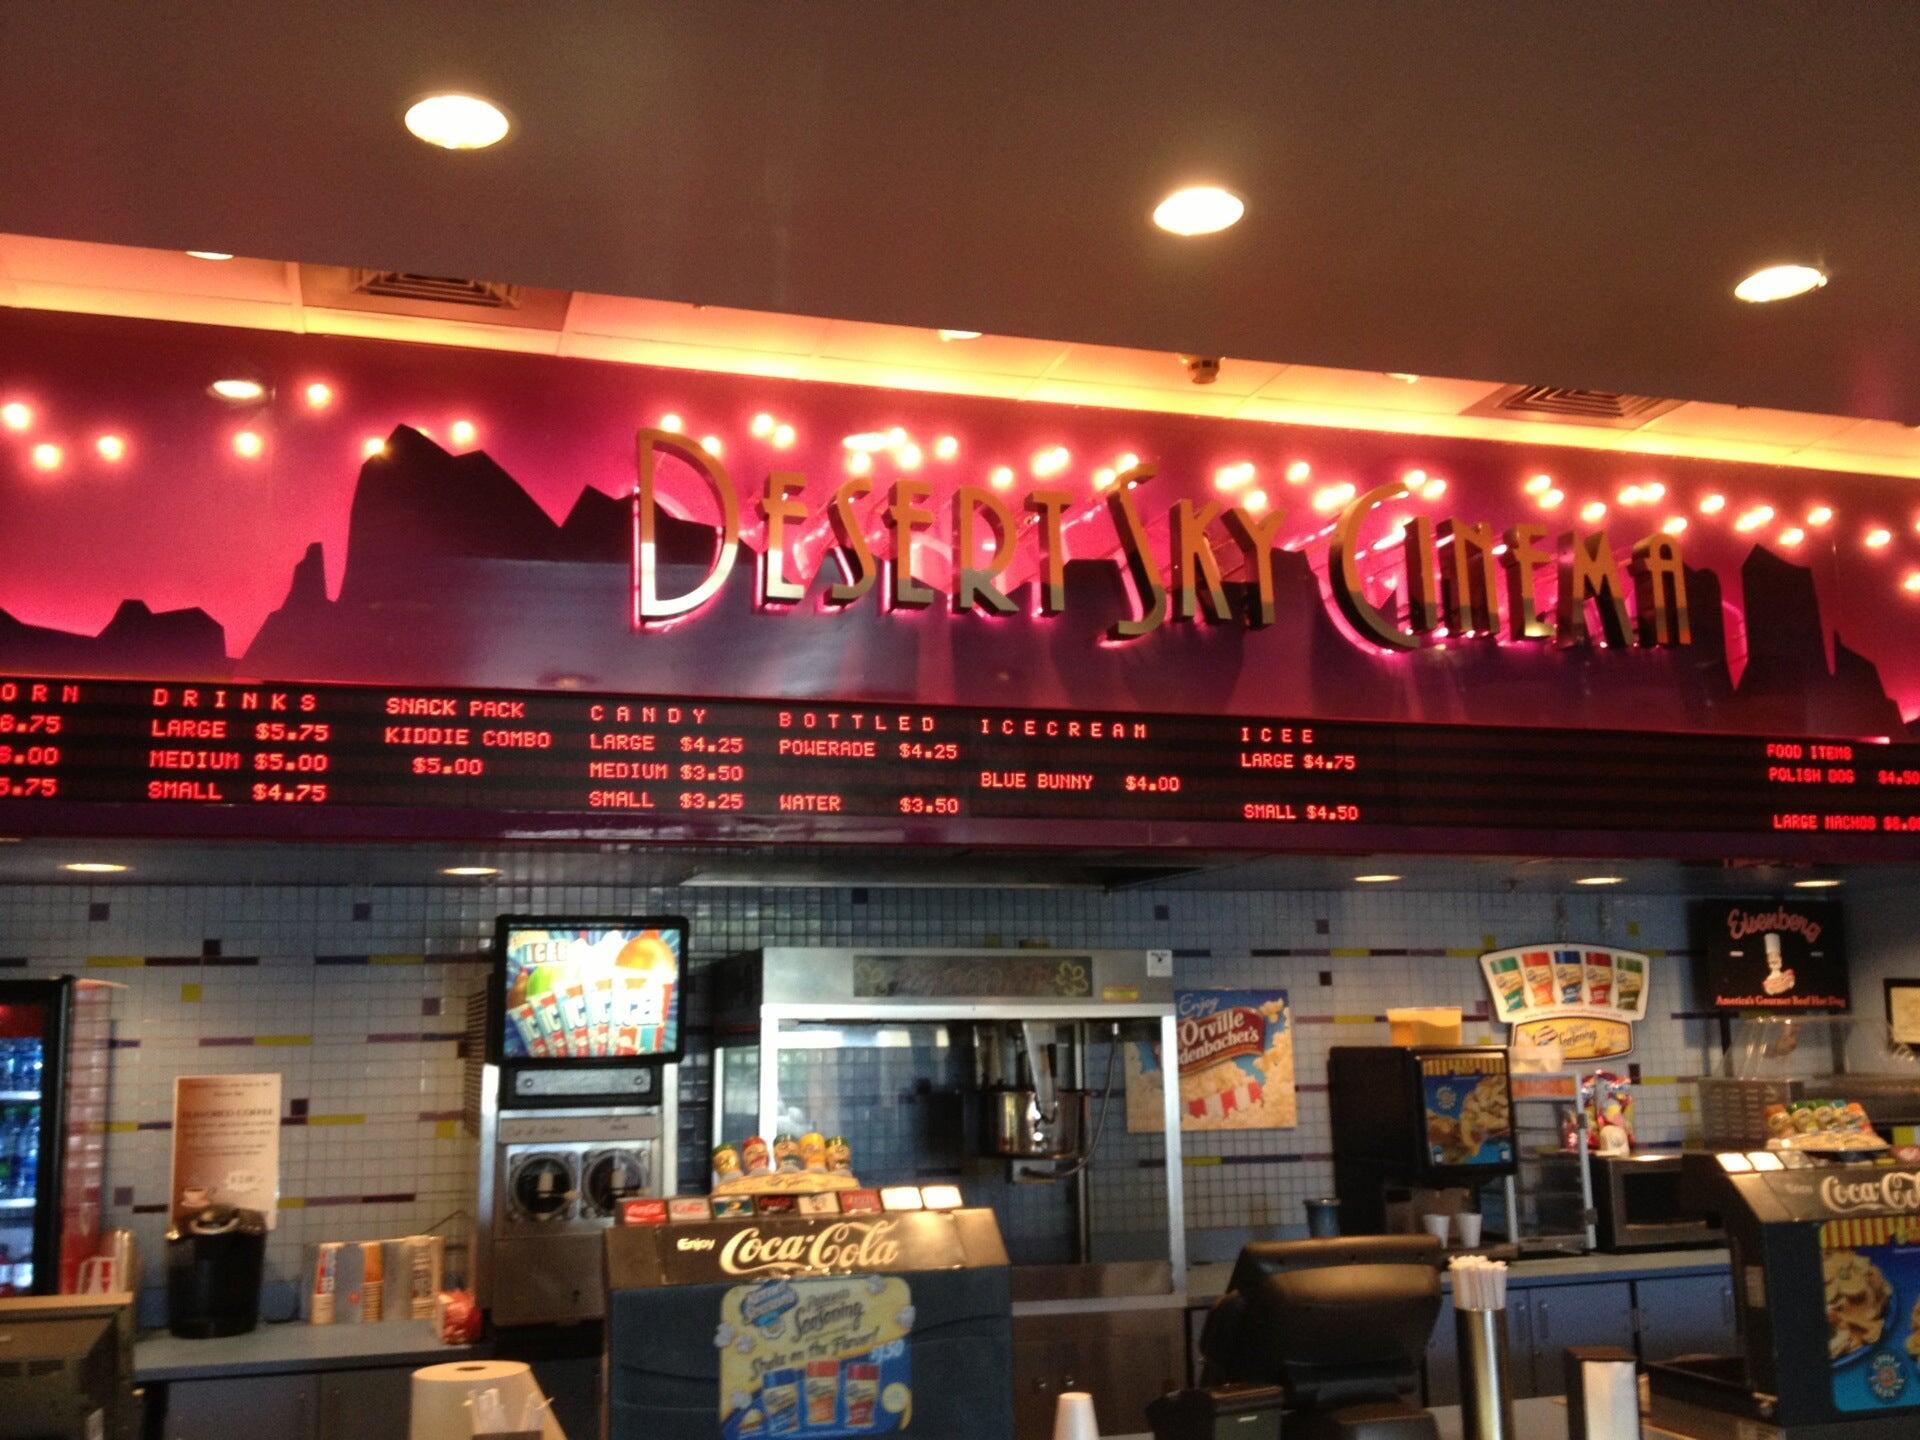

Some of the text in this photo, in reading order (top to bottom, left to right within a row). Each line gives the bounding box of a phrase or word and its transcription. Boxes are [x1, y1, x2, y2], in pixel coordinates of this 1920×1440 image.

[152, 688, 318, 712] DRINKS
[385, 697, 526, 719] SNACK PACK
[589, 705, 708, 725] CANDY
[777, 711, 936, 732] BOTTLED
[151, 719, 331, 743] LARGE $5.75
[384, 727, 552, 749] KIDDIE COMBO
[981, 718, 1149, 739] ICECREAM
[1241, 727, 1314, 744] ICEE
[589, 733, 745, 754] LARGE $4.25
[778, 738, 959, 760] POWERADE $4.25
[1765, 744, 1853, 761] FOOD ITEMS
[149, 750, 330, 772] MEDIUM $5.00
[411, 757, 485, 776] $5.00
[588, 761, 745, 782] MEDIUM $3.50
[1240, 752, 1357, 771] LARGE $4.75
[979, 771, 1182, 793] BLUE BUNNY $4.00
[1768, 767, 1824, 784] POLISH
[1827, 768, 1856, 784] DOG
[148, 781, 328, 802] SMALL $4.75
[588, 790, 745, 811] SMALL $3.25
[778, 794, 961, 815] WATER $3.50
[1243, 803, 1361, 822] SMALL $4.50
[1772, 814, 1819, 831] LARGE
[1181, 1008, 1246, 1047] Orville
[719, 1219, 899, 1276] Coca-Cola
